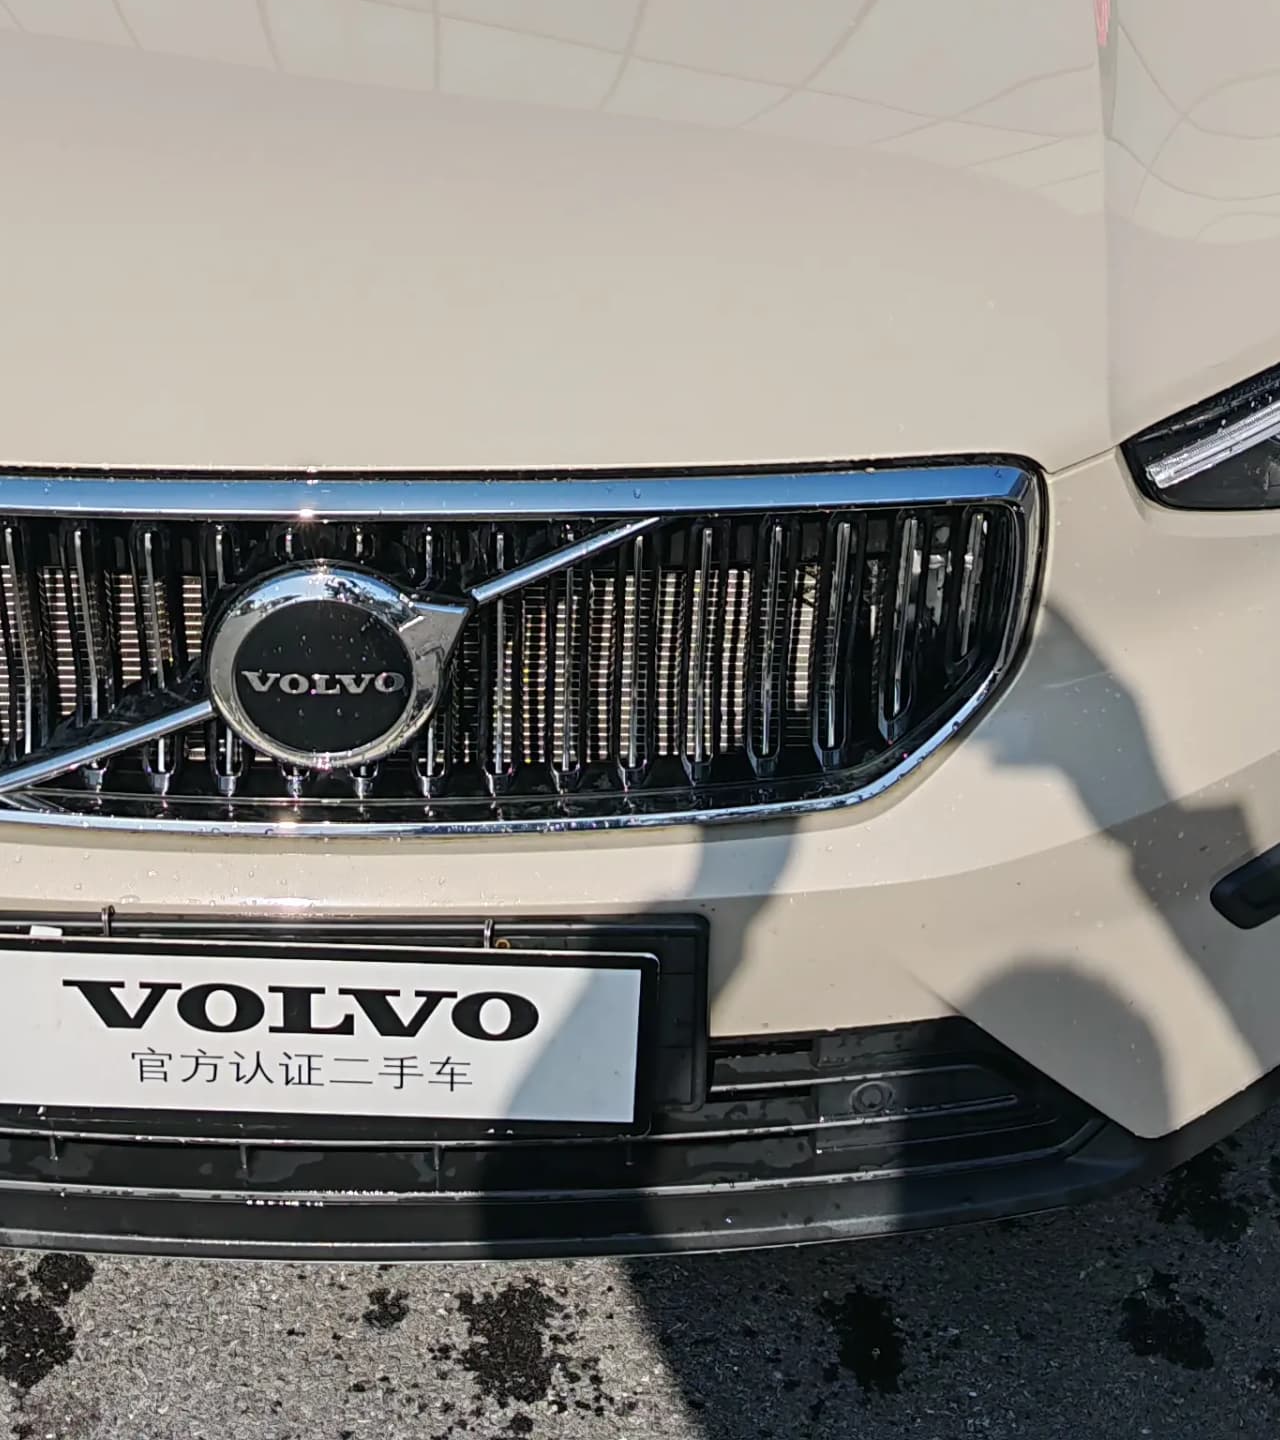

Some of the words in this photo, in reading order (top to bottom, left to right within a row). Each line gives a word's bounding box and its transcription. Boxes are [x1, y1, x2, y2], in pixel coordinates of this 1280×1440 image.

[241, 670, 405, 694] VOLVO
[62, 979, 539, 1042] VOLVO
[131, 1047, 473, 1092] 官方认证二手车
